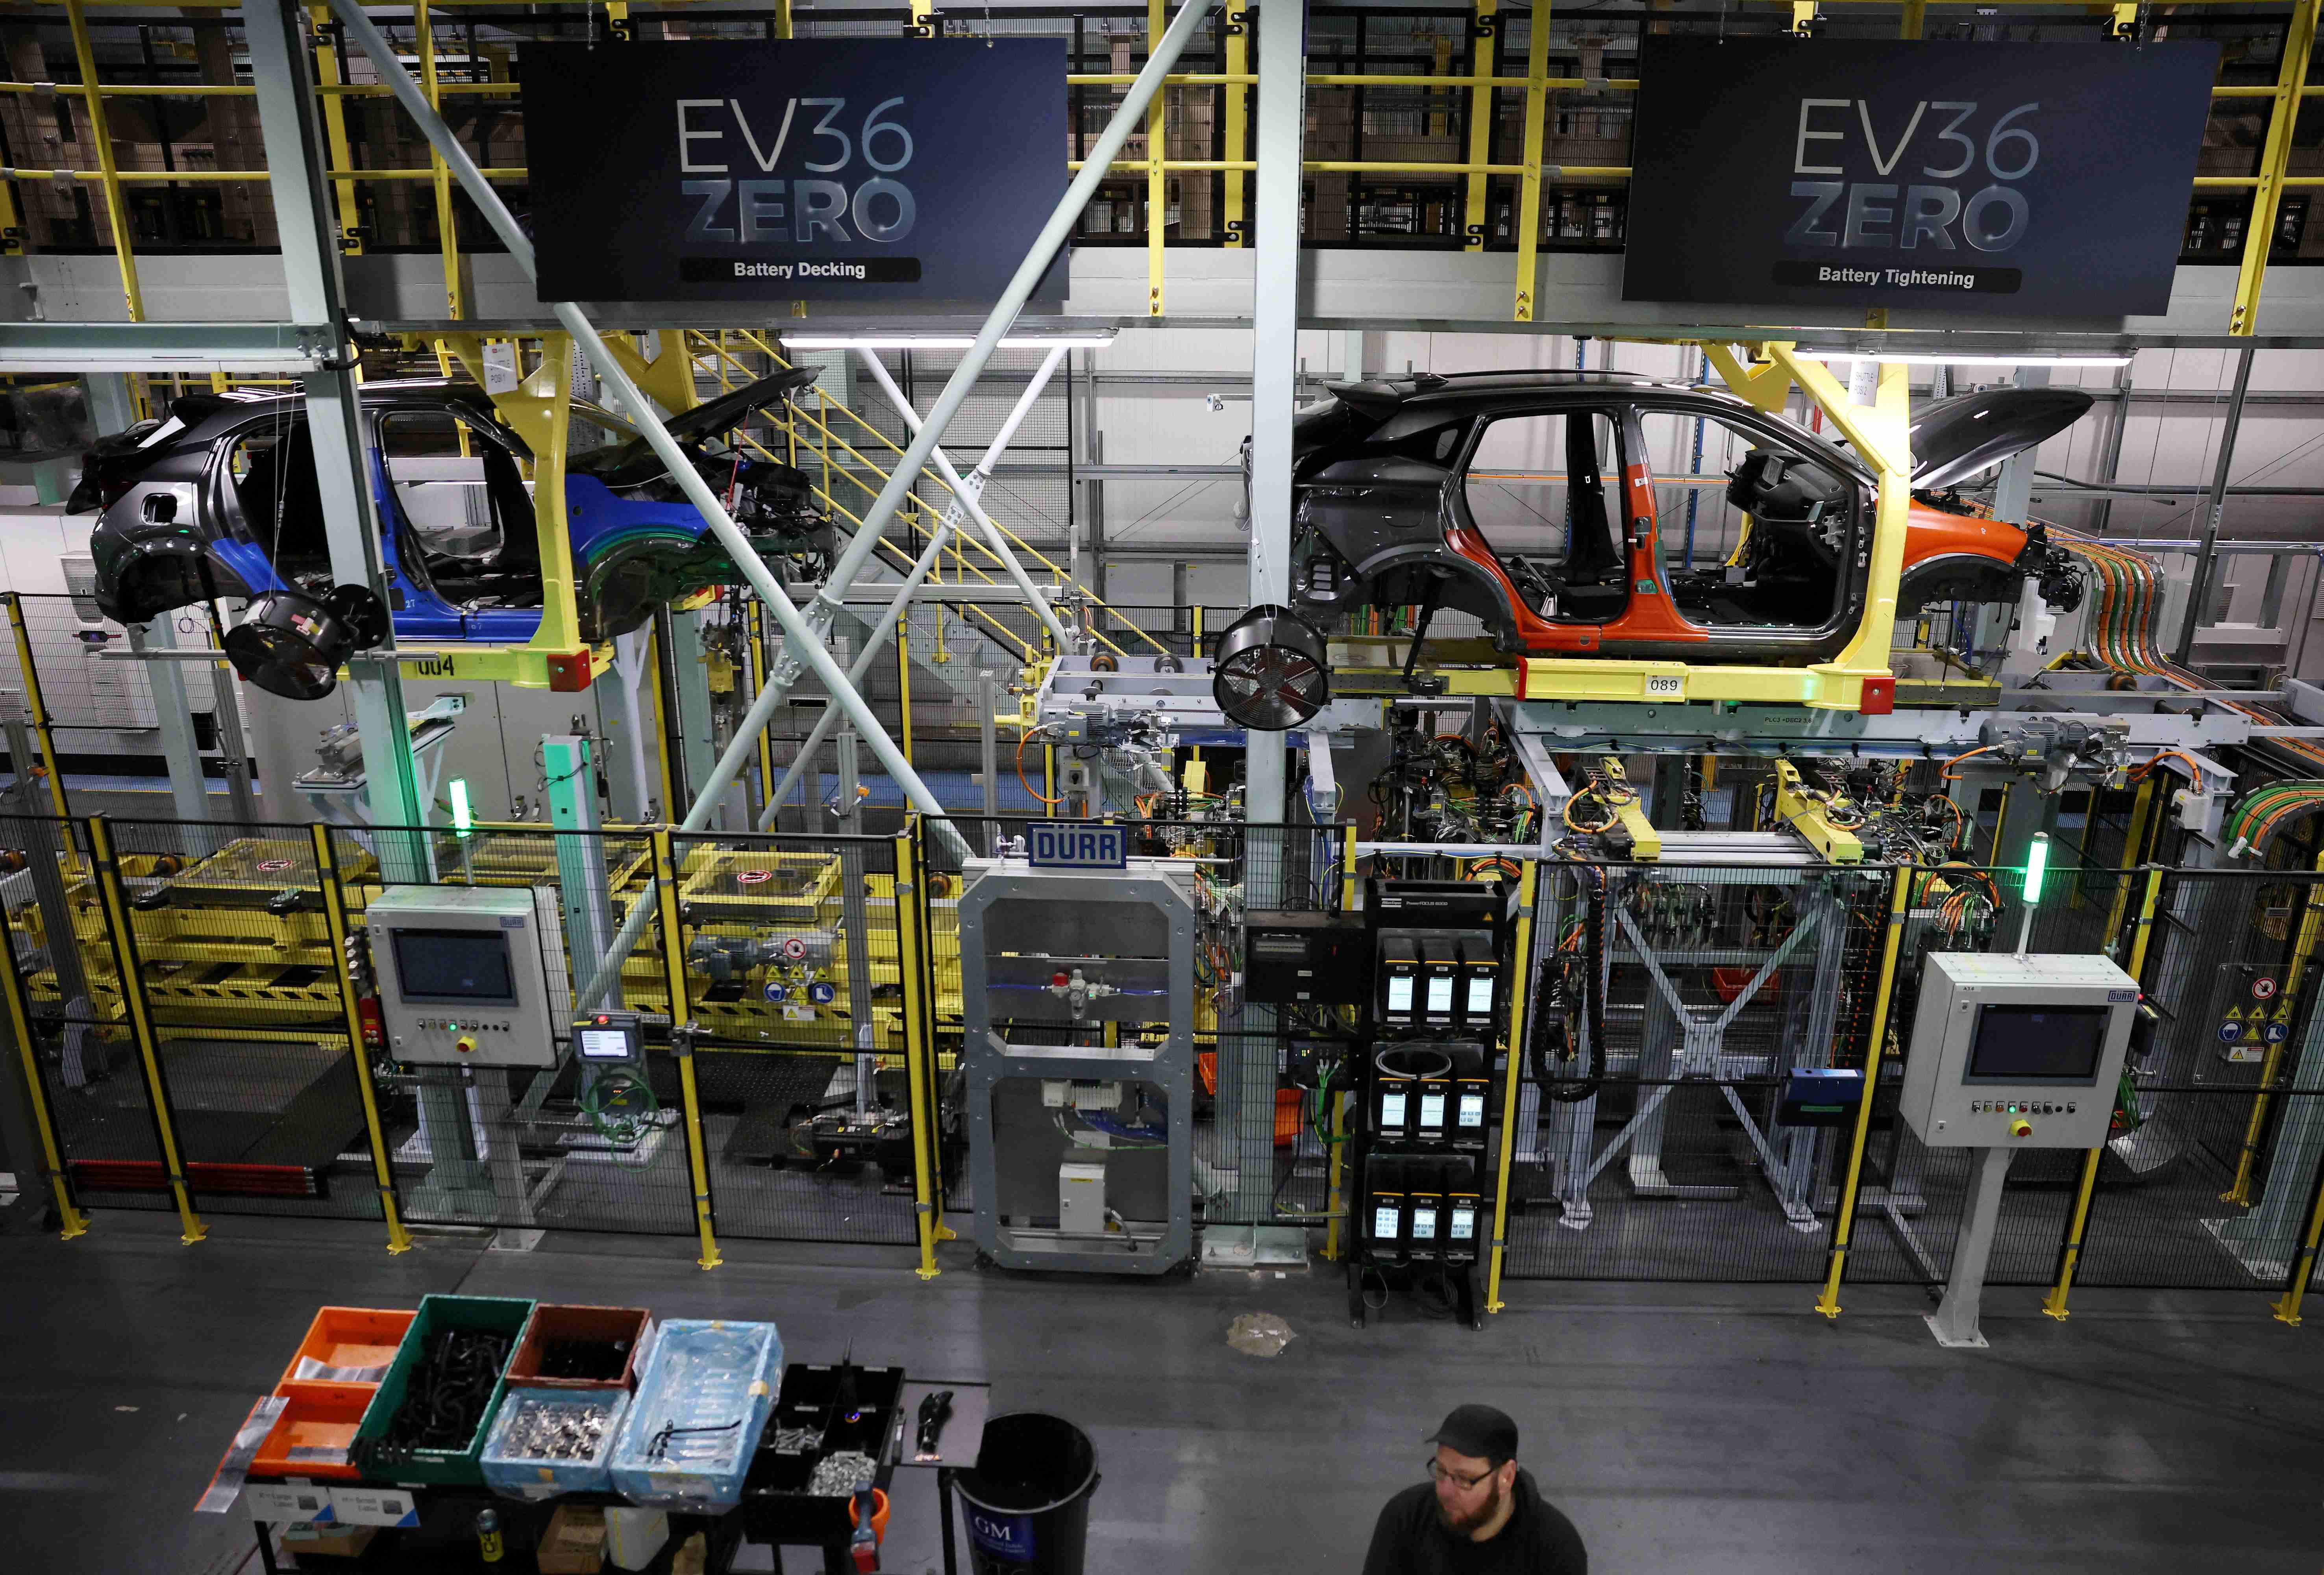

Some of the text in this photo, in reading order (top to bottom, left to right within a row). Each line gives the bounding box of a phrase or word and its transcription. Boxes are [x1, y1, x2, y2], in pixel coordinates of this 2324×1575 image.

[677, 96, 914, 172] EV36
[1793, 98, 2039, 180] EV36
[681, 178, 916, 243] ZERO
[1784, 182, 2030, 252] ZERO
[734, 261, 866, 280] Battery Decking
[1819, 267, 1975, 289] Battery Tightening
[1856, 372, 1873, 382] SHUTTLE
[418, 655, 454, 676] 004
[1651, 680, 1677, 690] 089
[975, 1516, 1011, 1541] GM
